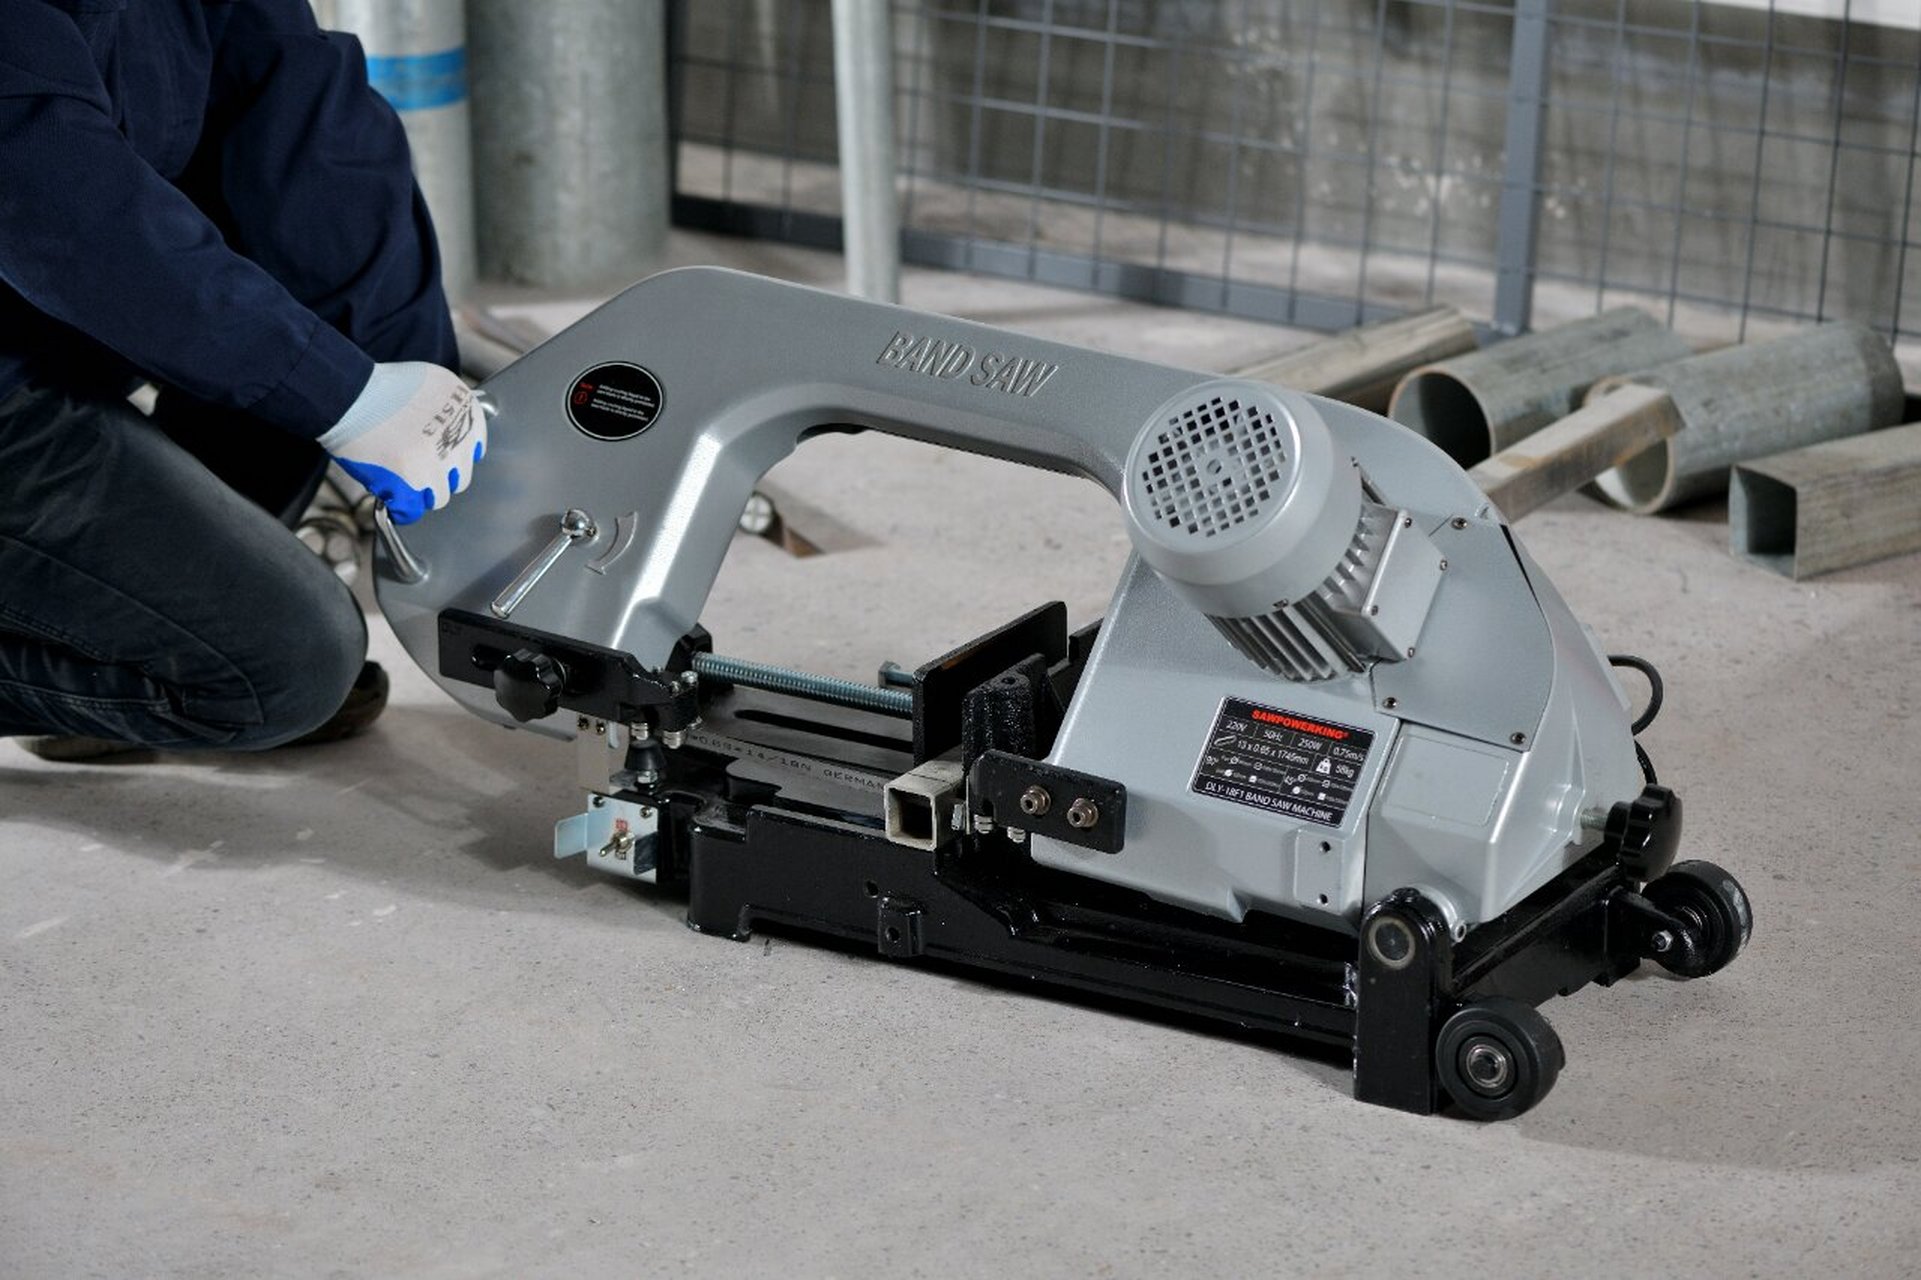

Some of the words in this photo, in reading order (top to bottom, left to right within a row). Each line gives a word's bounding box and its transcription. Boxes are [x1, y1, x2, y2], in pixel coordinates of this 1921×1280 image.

[875, 330, 976, 379] BAND
[970, 351, 1059, 397] SAW
[1226, 720, 1247, 732] 220V
[1263, 729, 1284, 742] 50Hz
[1237, 739, 1247, 750] 13
[1297, 737, 1323, 750] 250W
[1245, 791, 1271, 806] BAND
[1271, 797, 1292, 811] SAW
[1292, 803, 1334, 822] MACHINE
